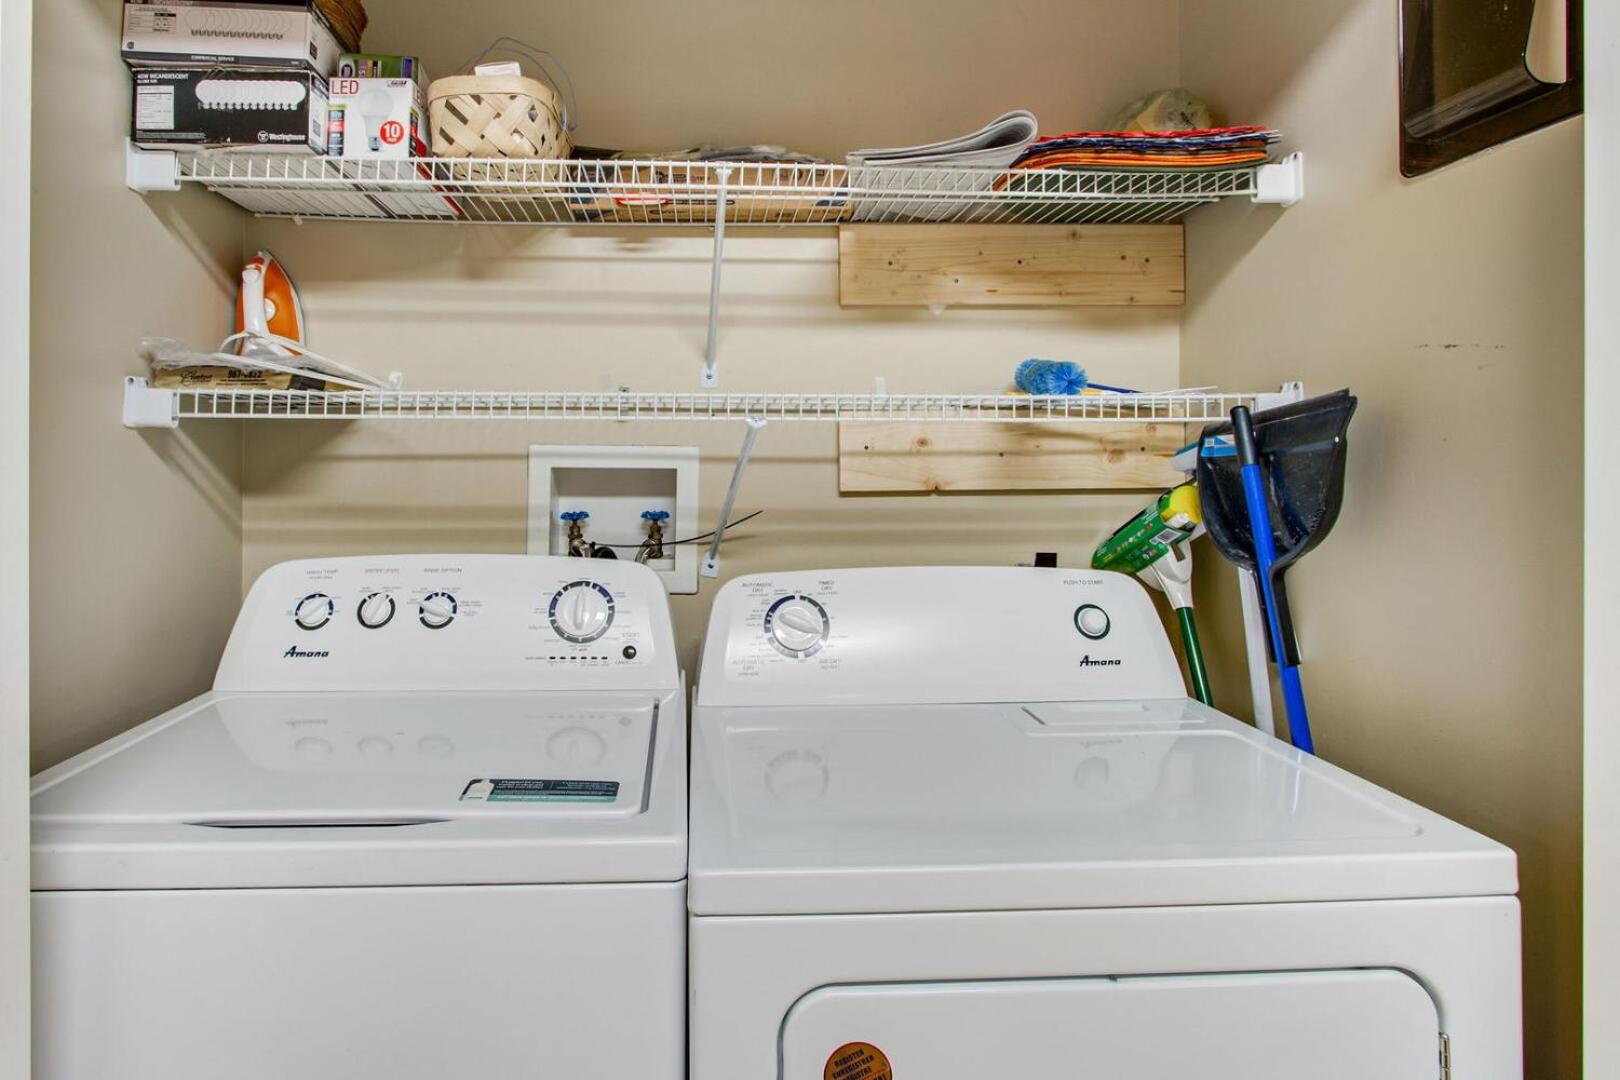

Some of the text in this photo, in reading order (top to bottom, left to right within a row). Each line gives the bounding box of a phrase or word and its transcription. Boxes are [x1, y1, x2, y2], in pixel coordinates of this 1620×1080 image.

[331, 80, 359, 95] LED
[384, 123, 401, 138] 10
[283, 645, 329, 658] Amana
[1080, 655, 1121, 667] Amana
